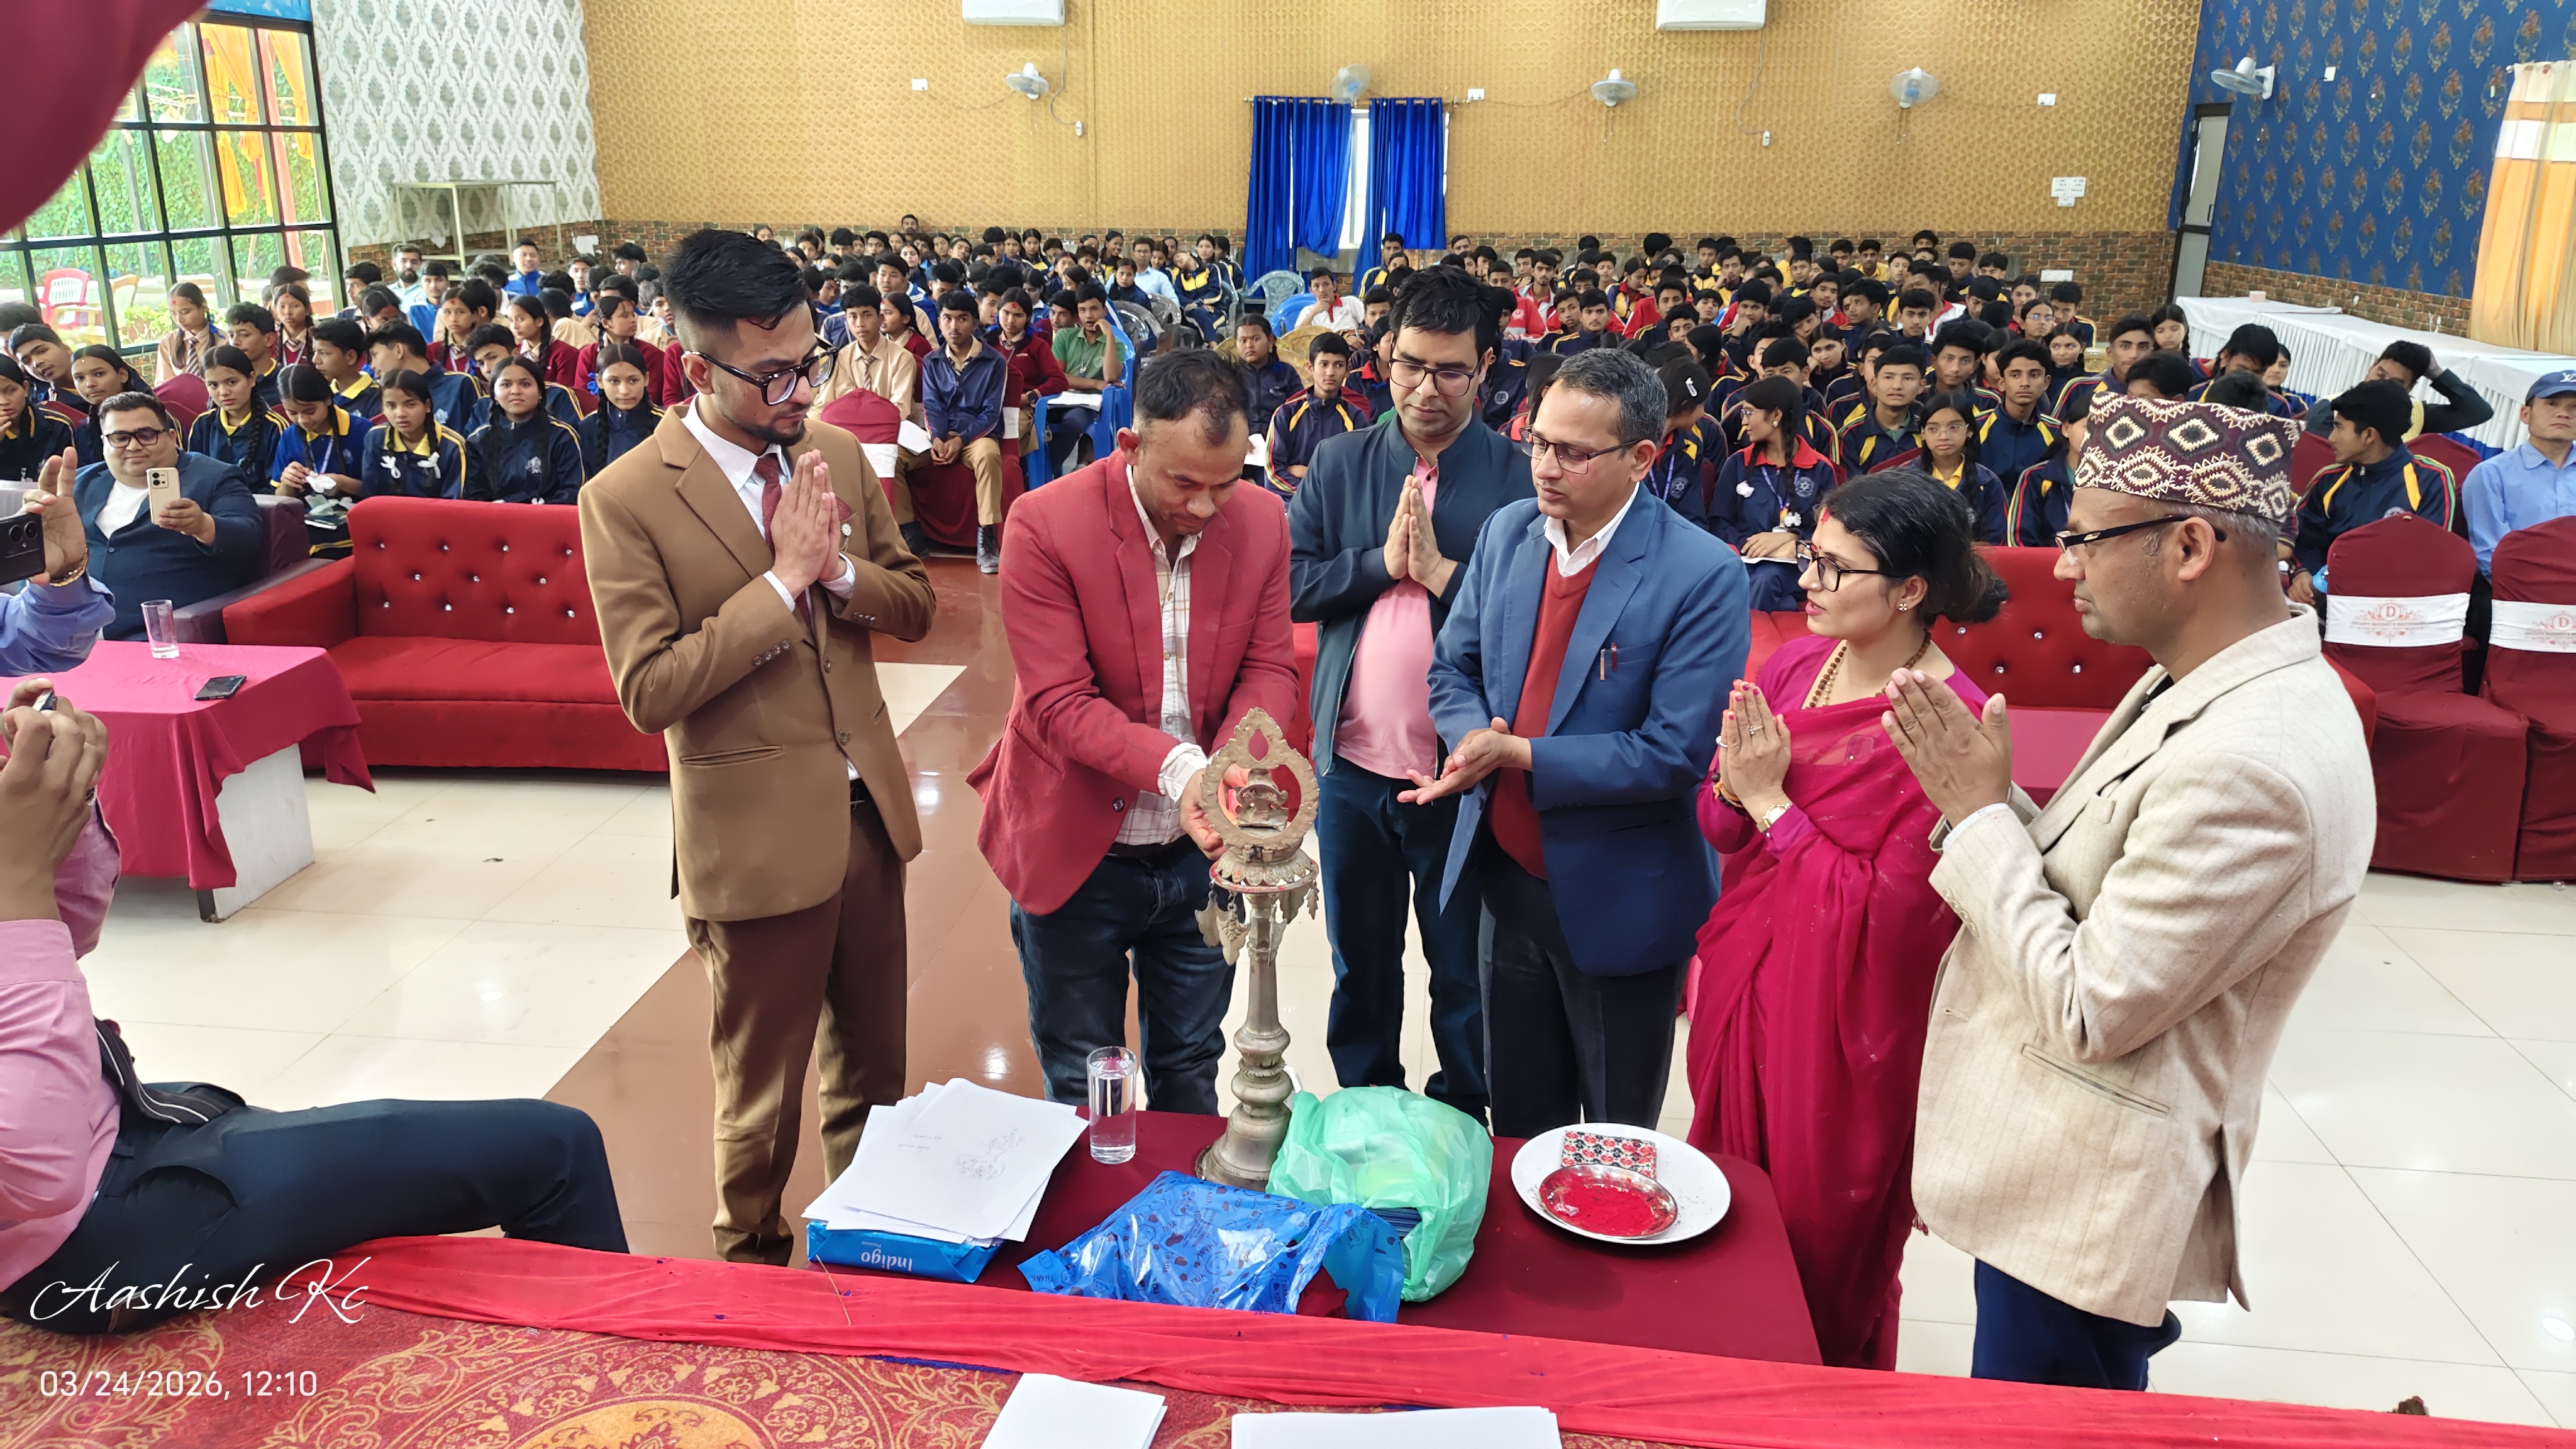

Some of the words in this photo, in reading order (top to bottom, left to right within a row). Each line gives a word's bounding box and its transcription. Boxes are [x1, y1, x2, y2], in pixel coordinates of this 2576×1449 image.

[2386, 606, 2396, 617] D
[2559, 617, 2569, 628] D
[1197, 1240, 1219, 1260] THANK
[861, 1248, 913, 1272] Indigo
[1030, 1274, 1055, 1283] THANK
